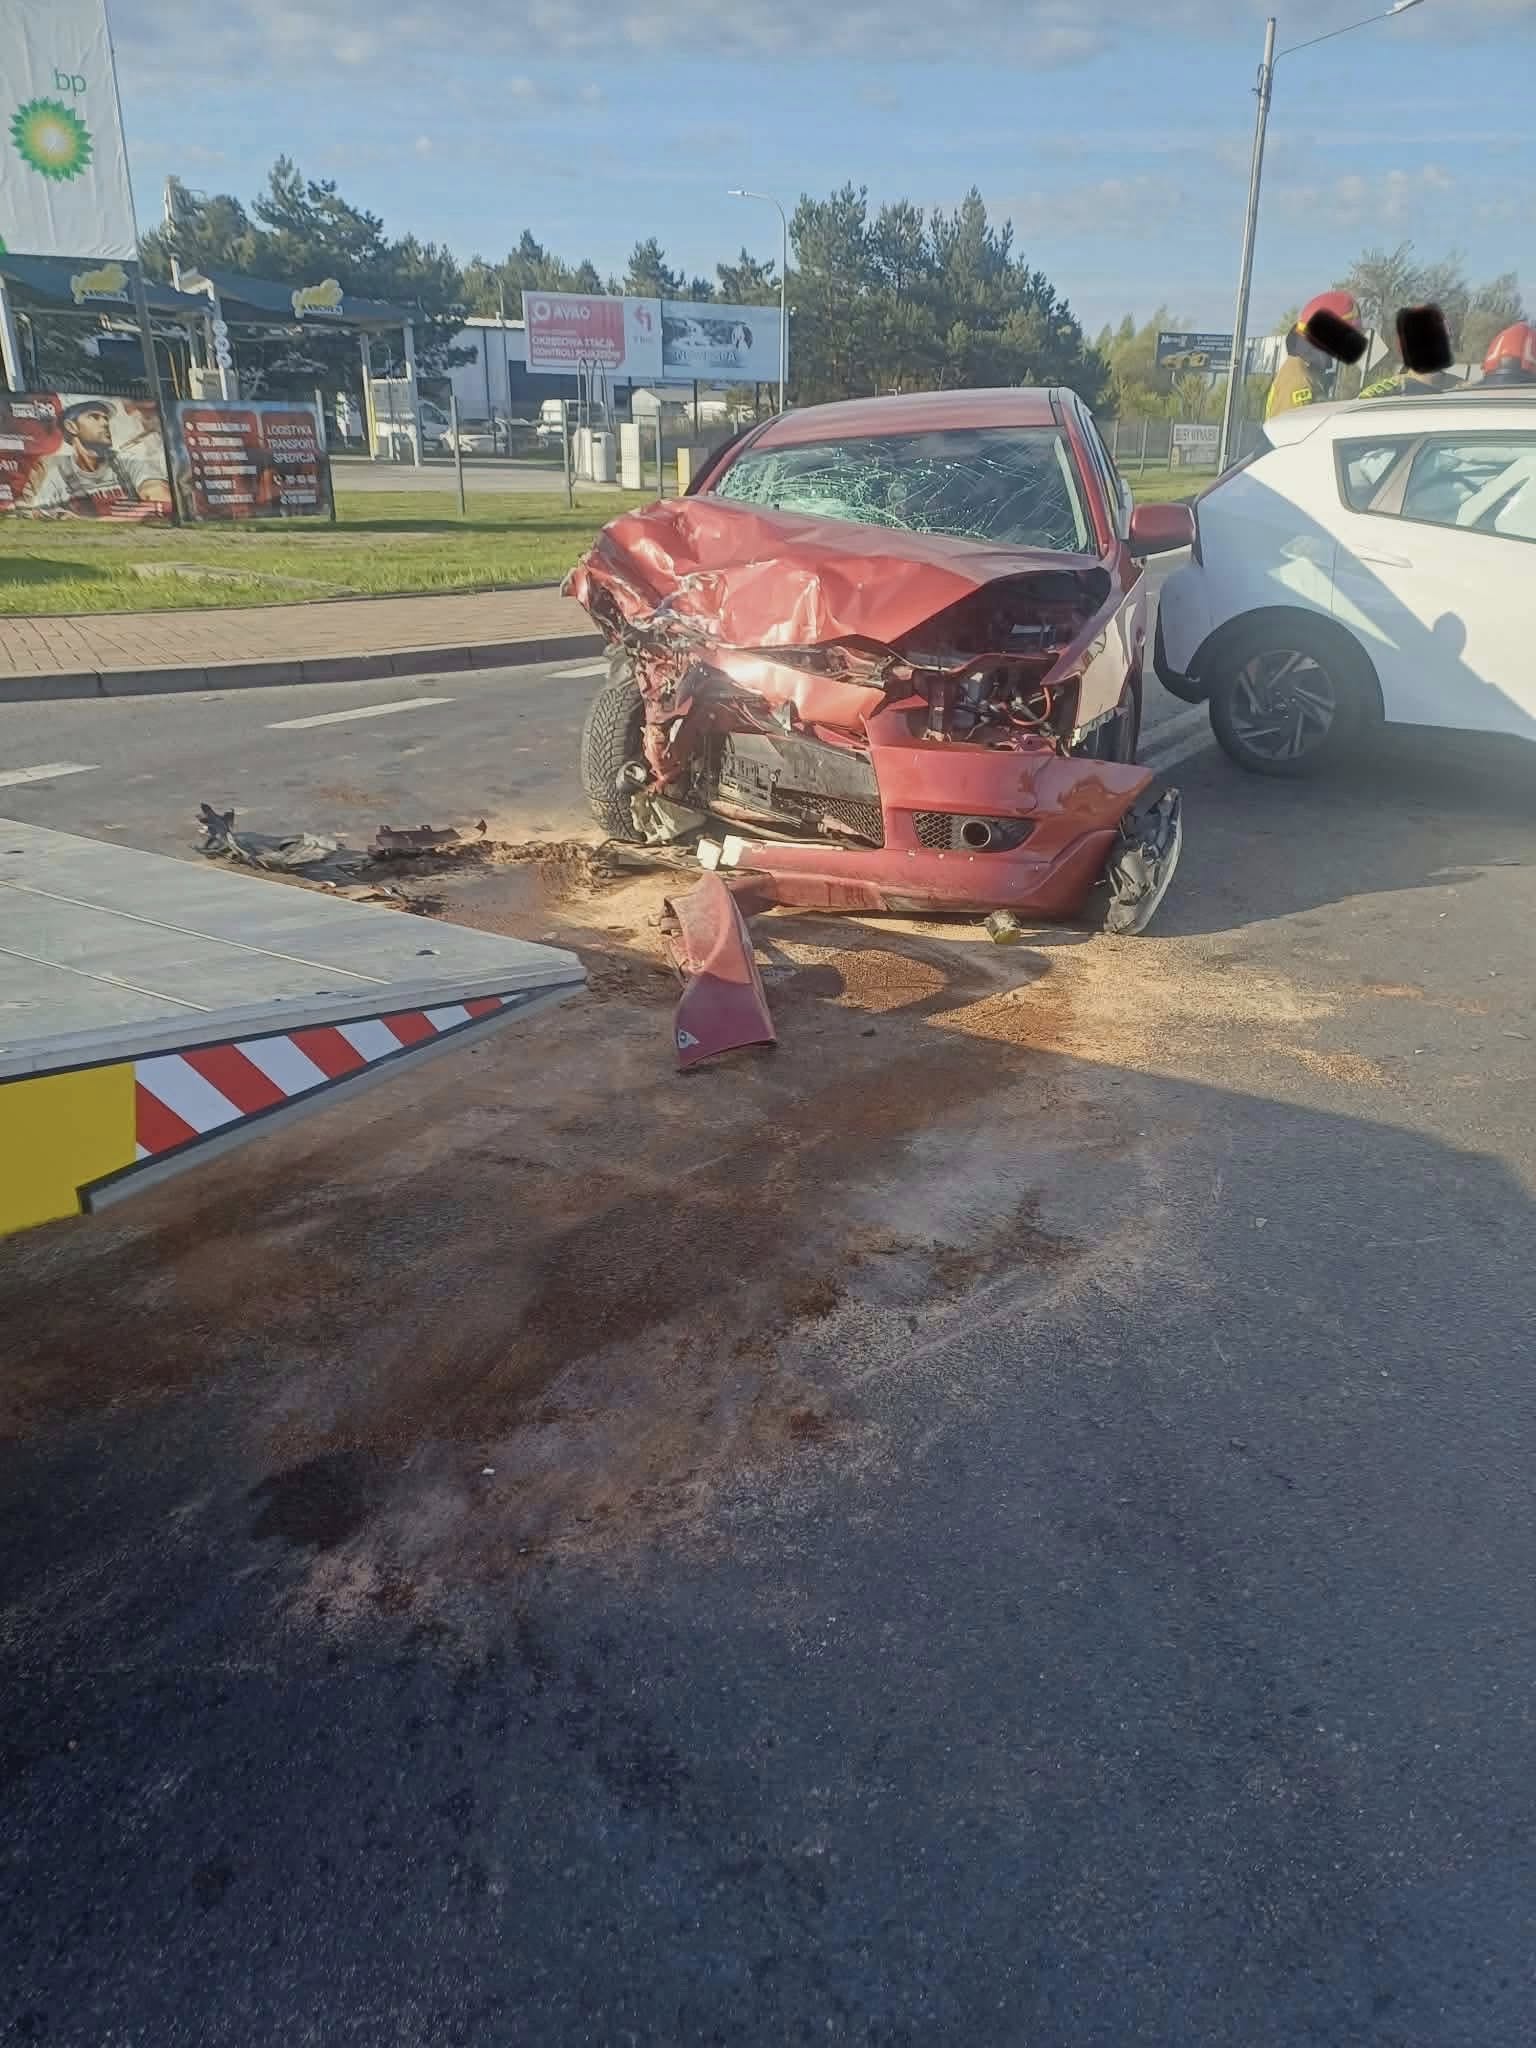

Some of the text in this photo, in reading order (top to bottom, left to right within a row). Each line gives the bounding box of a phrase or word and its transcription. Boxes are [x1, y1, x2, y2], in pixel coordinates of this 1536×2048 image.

[54, 68, 86, 96] bp
[266, 424, 313, 437] LOGISTYKA
[266, 438, 315, 450] TRANSPORT
[272, 452, 316, 464] SPEDYCJA
